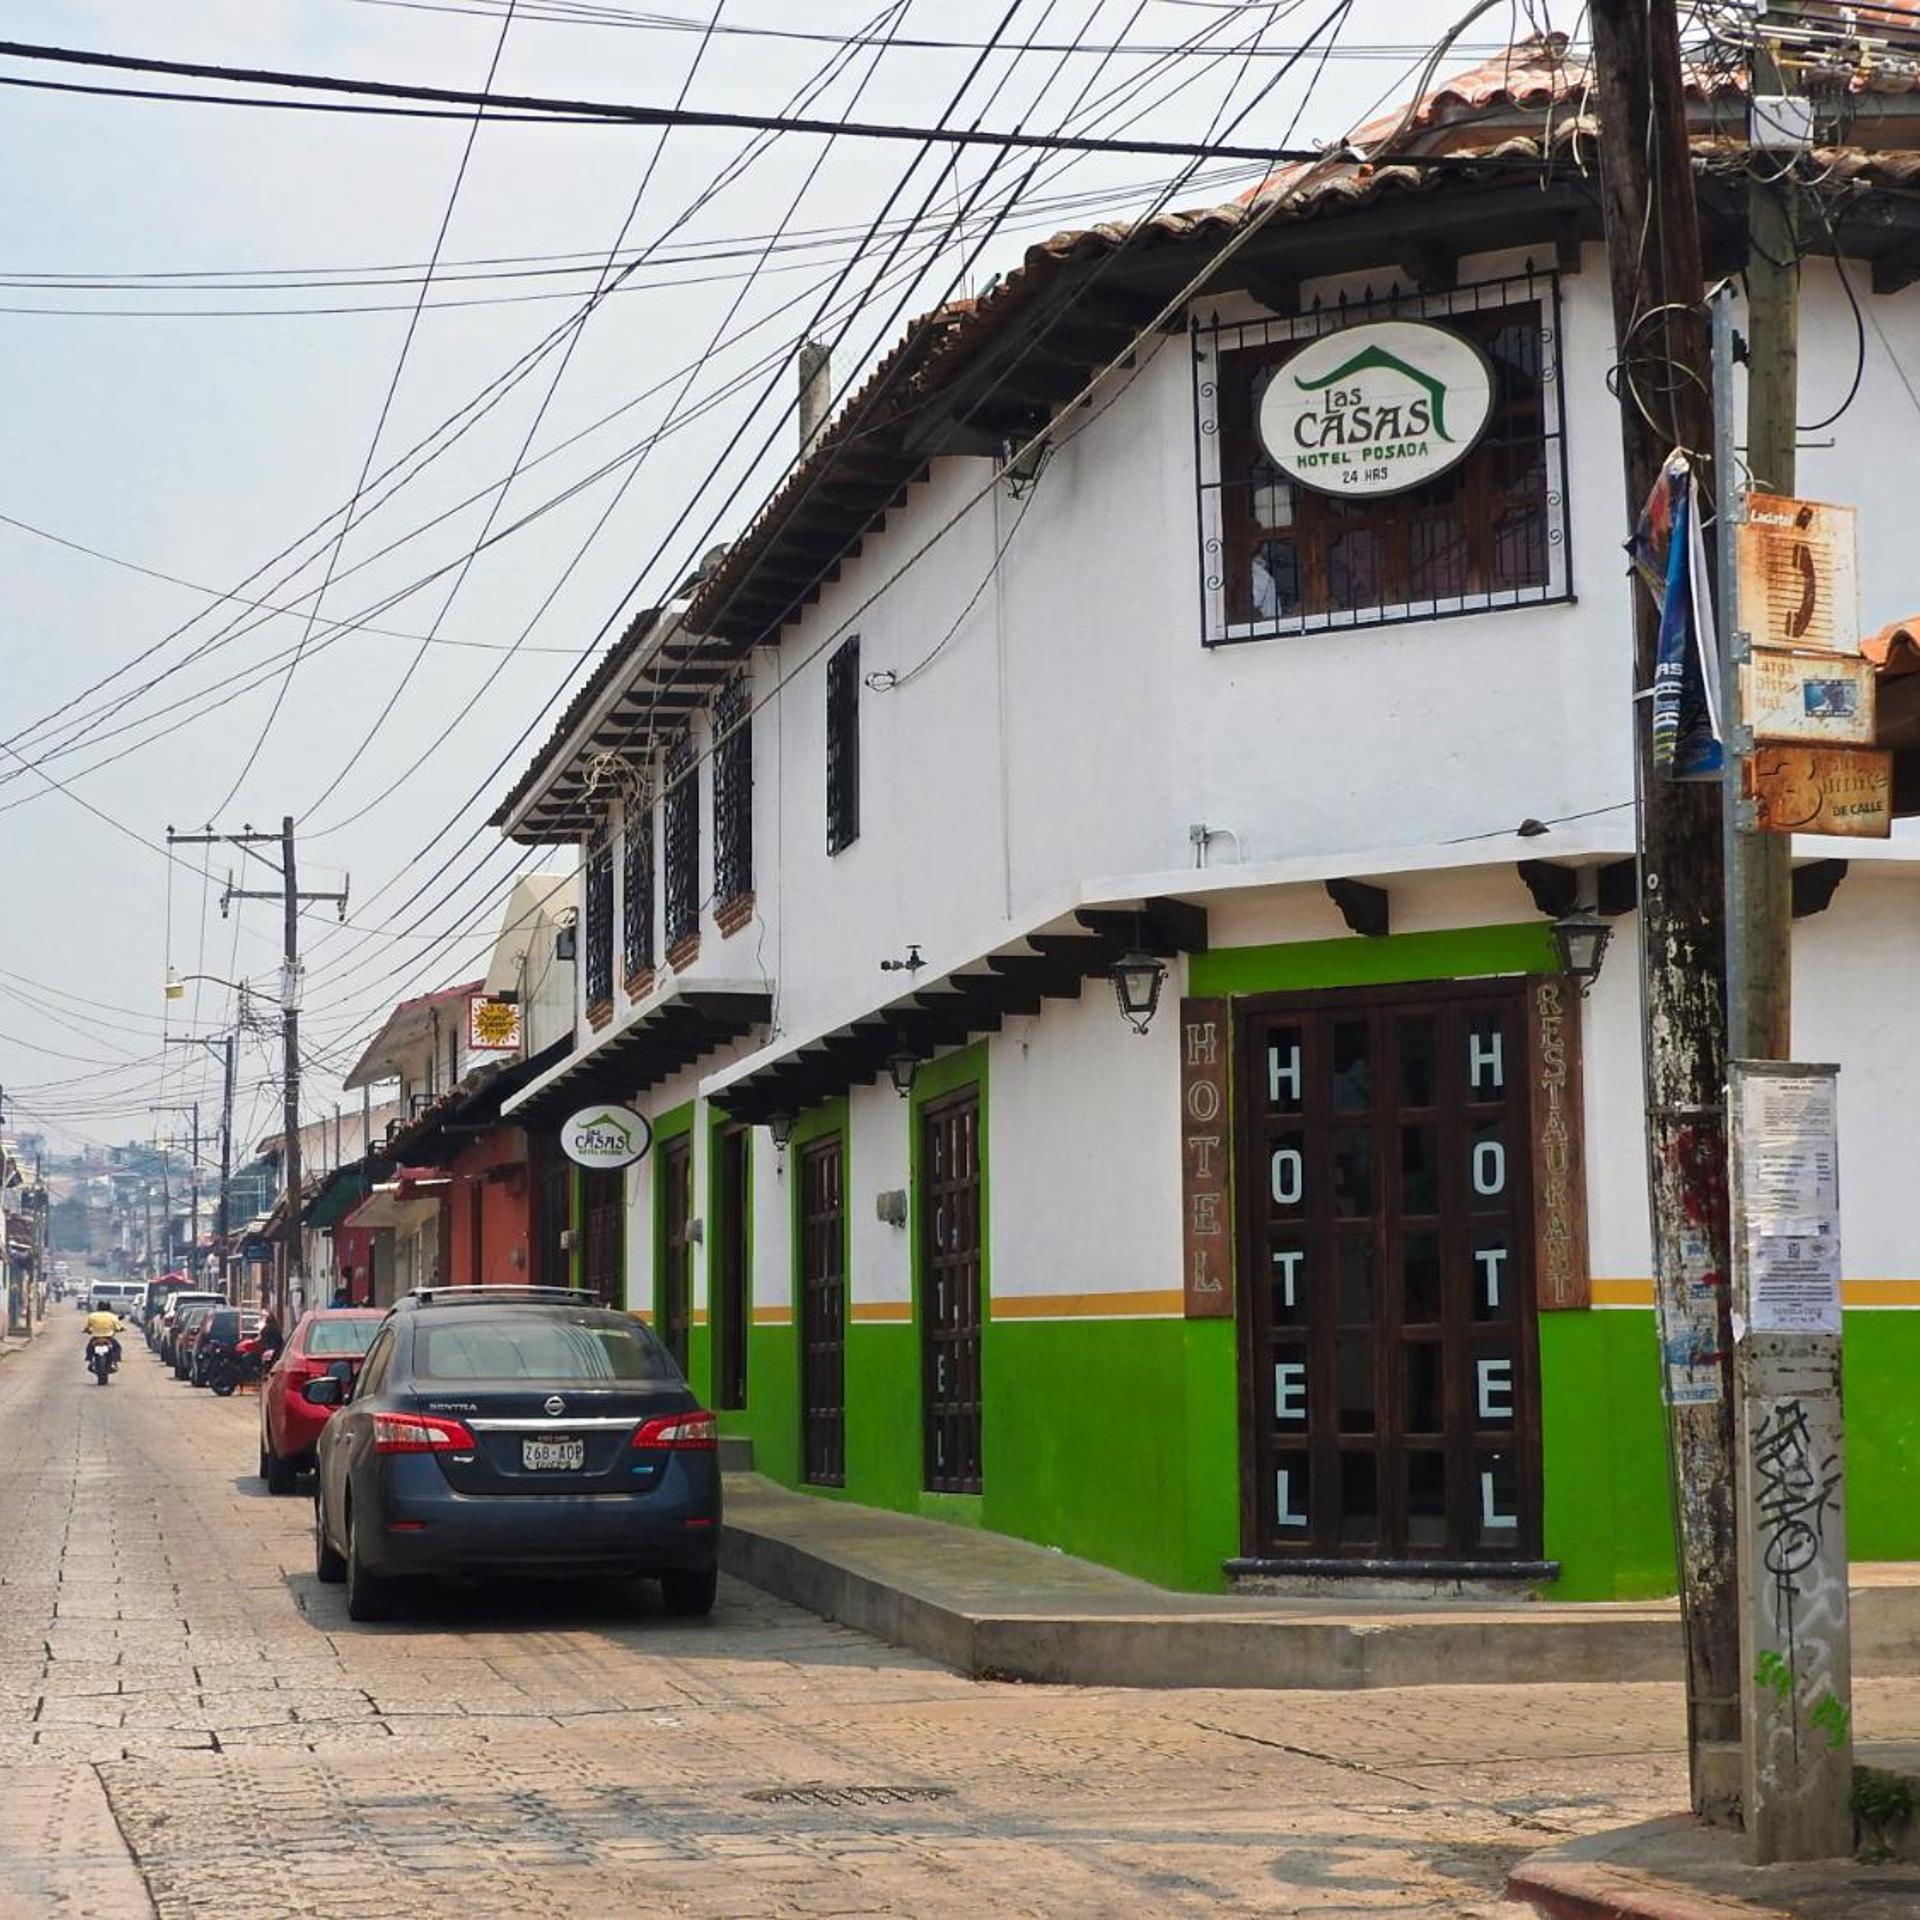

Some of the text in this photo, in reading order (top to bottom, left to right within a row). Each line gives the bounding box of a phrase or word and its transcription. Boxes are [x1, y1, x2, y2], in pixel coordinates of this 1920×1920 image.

[1294, 399, 1430, 449] CASAS
[1324, 388, 1362, 414] Las
[1297, 441, 1429, 469] HOTEL POSADA
[1342, 467, 1388, 484] 24 HRS
[575, 1135, 625, 1150] CASAS
[1186, 1022, 1222, 1294] HOTEL
[1537, 984, 1572, 1302] RESTAURANT
[1268, 1046, 1307, 1526] HOTEL
[1469, 1033, 1517, 1528] HOTEL
